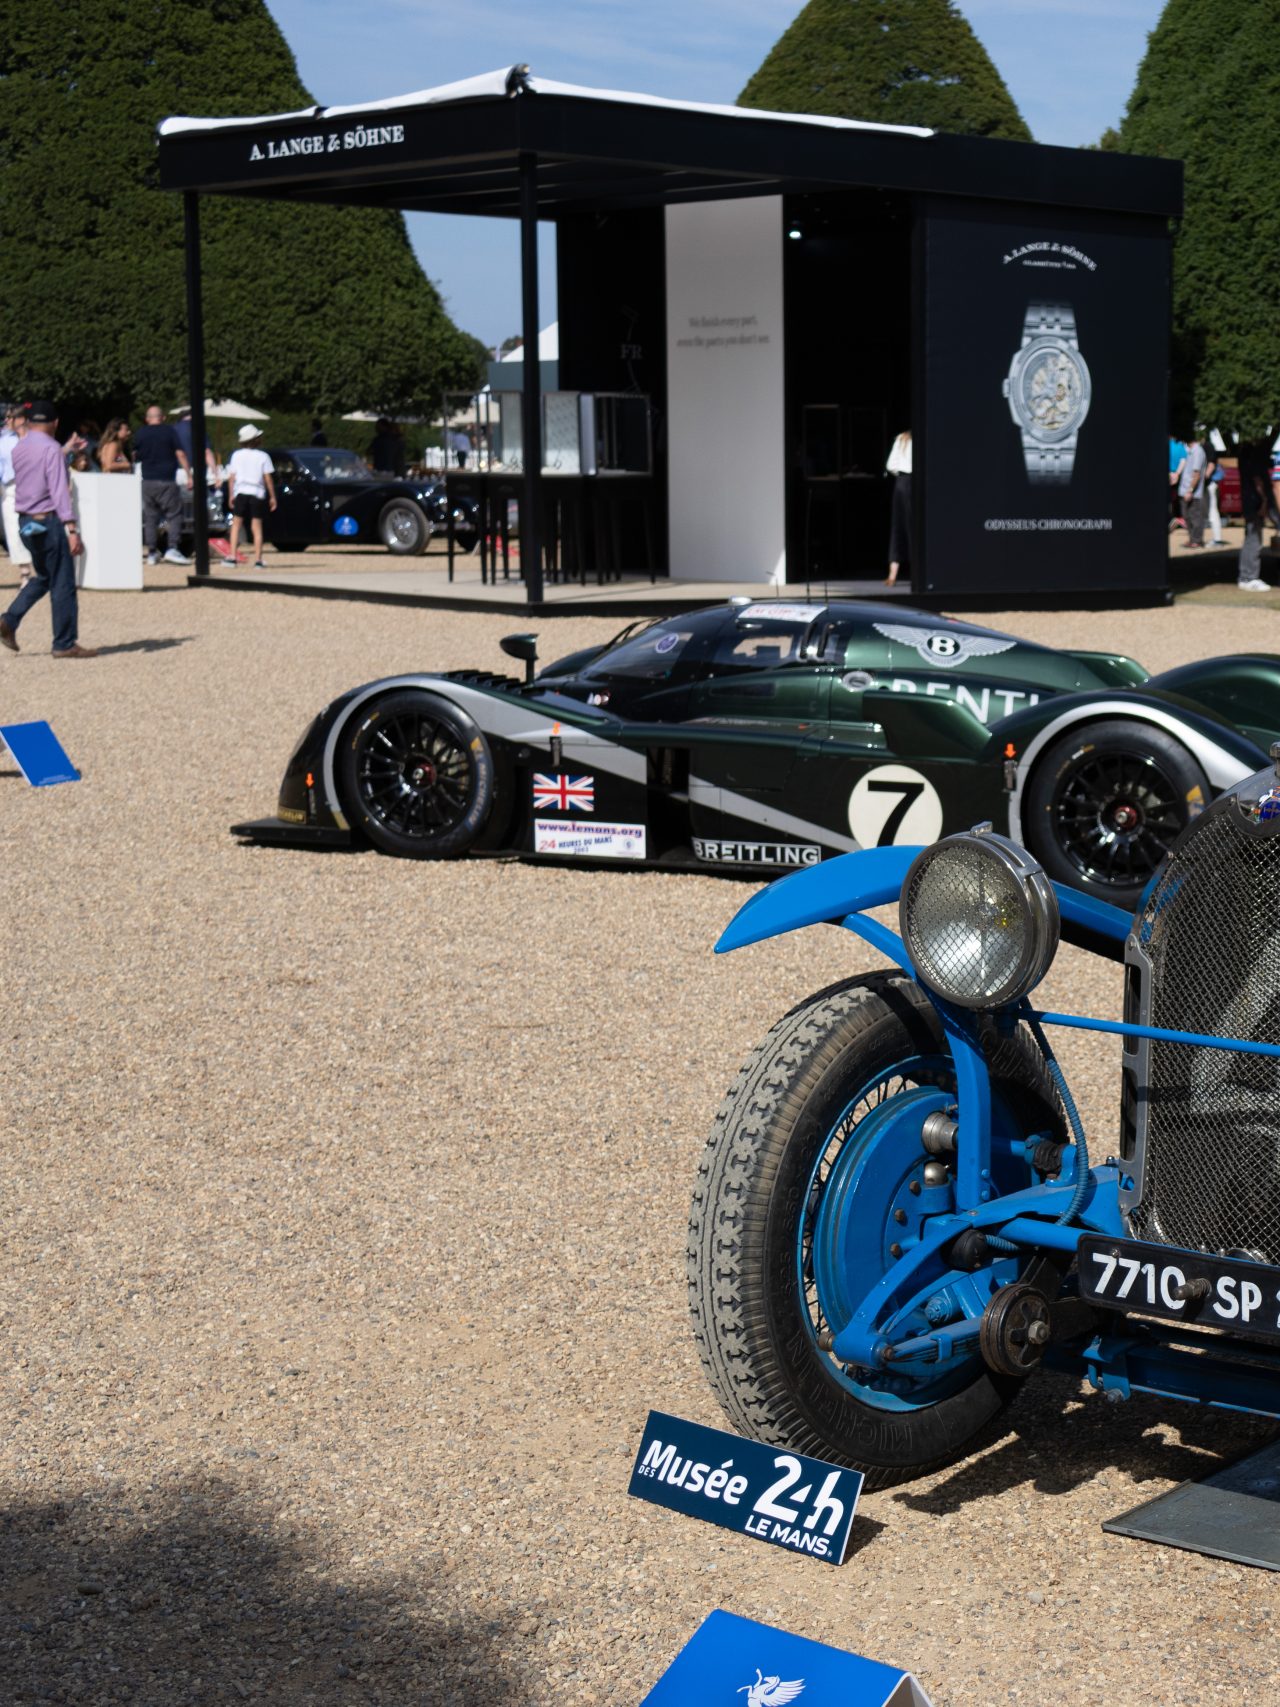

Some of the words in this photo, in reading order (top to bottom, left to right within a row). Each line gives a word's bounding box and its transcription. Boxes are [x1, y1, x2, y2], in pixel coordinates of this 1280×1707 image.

[249, 143, 265, 161] A.
[267, 136, 325, 159] LANGE
[327, 134, 341, 152] &
[343, 125, 405, 149] SÖHNE
[1038, 518, 1113, 531] CHRONOGRAPH
[867, 780, 924, 847] 7
[537, 821, 642, 838] www.lemans.org
[540, 840, 556, 852] 24
[694, 841, 819, 865] BREITLING
[1092, 1253, 1186, 1310] 7710
[1212, 1276, 1262, 1322] SP
[638, 1464, 656, 1478] DES
[641, 1439, 748, 1505] Musée
[752, 1455, 845, 1536] 24h
[744, 1514, 768, 1536] LE
